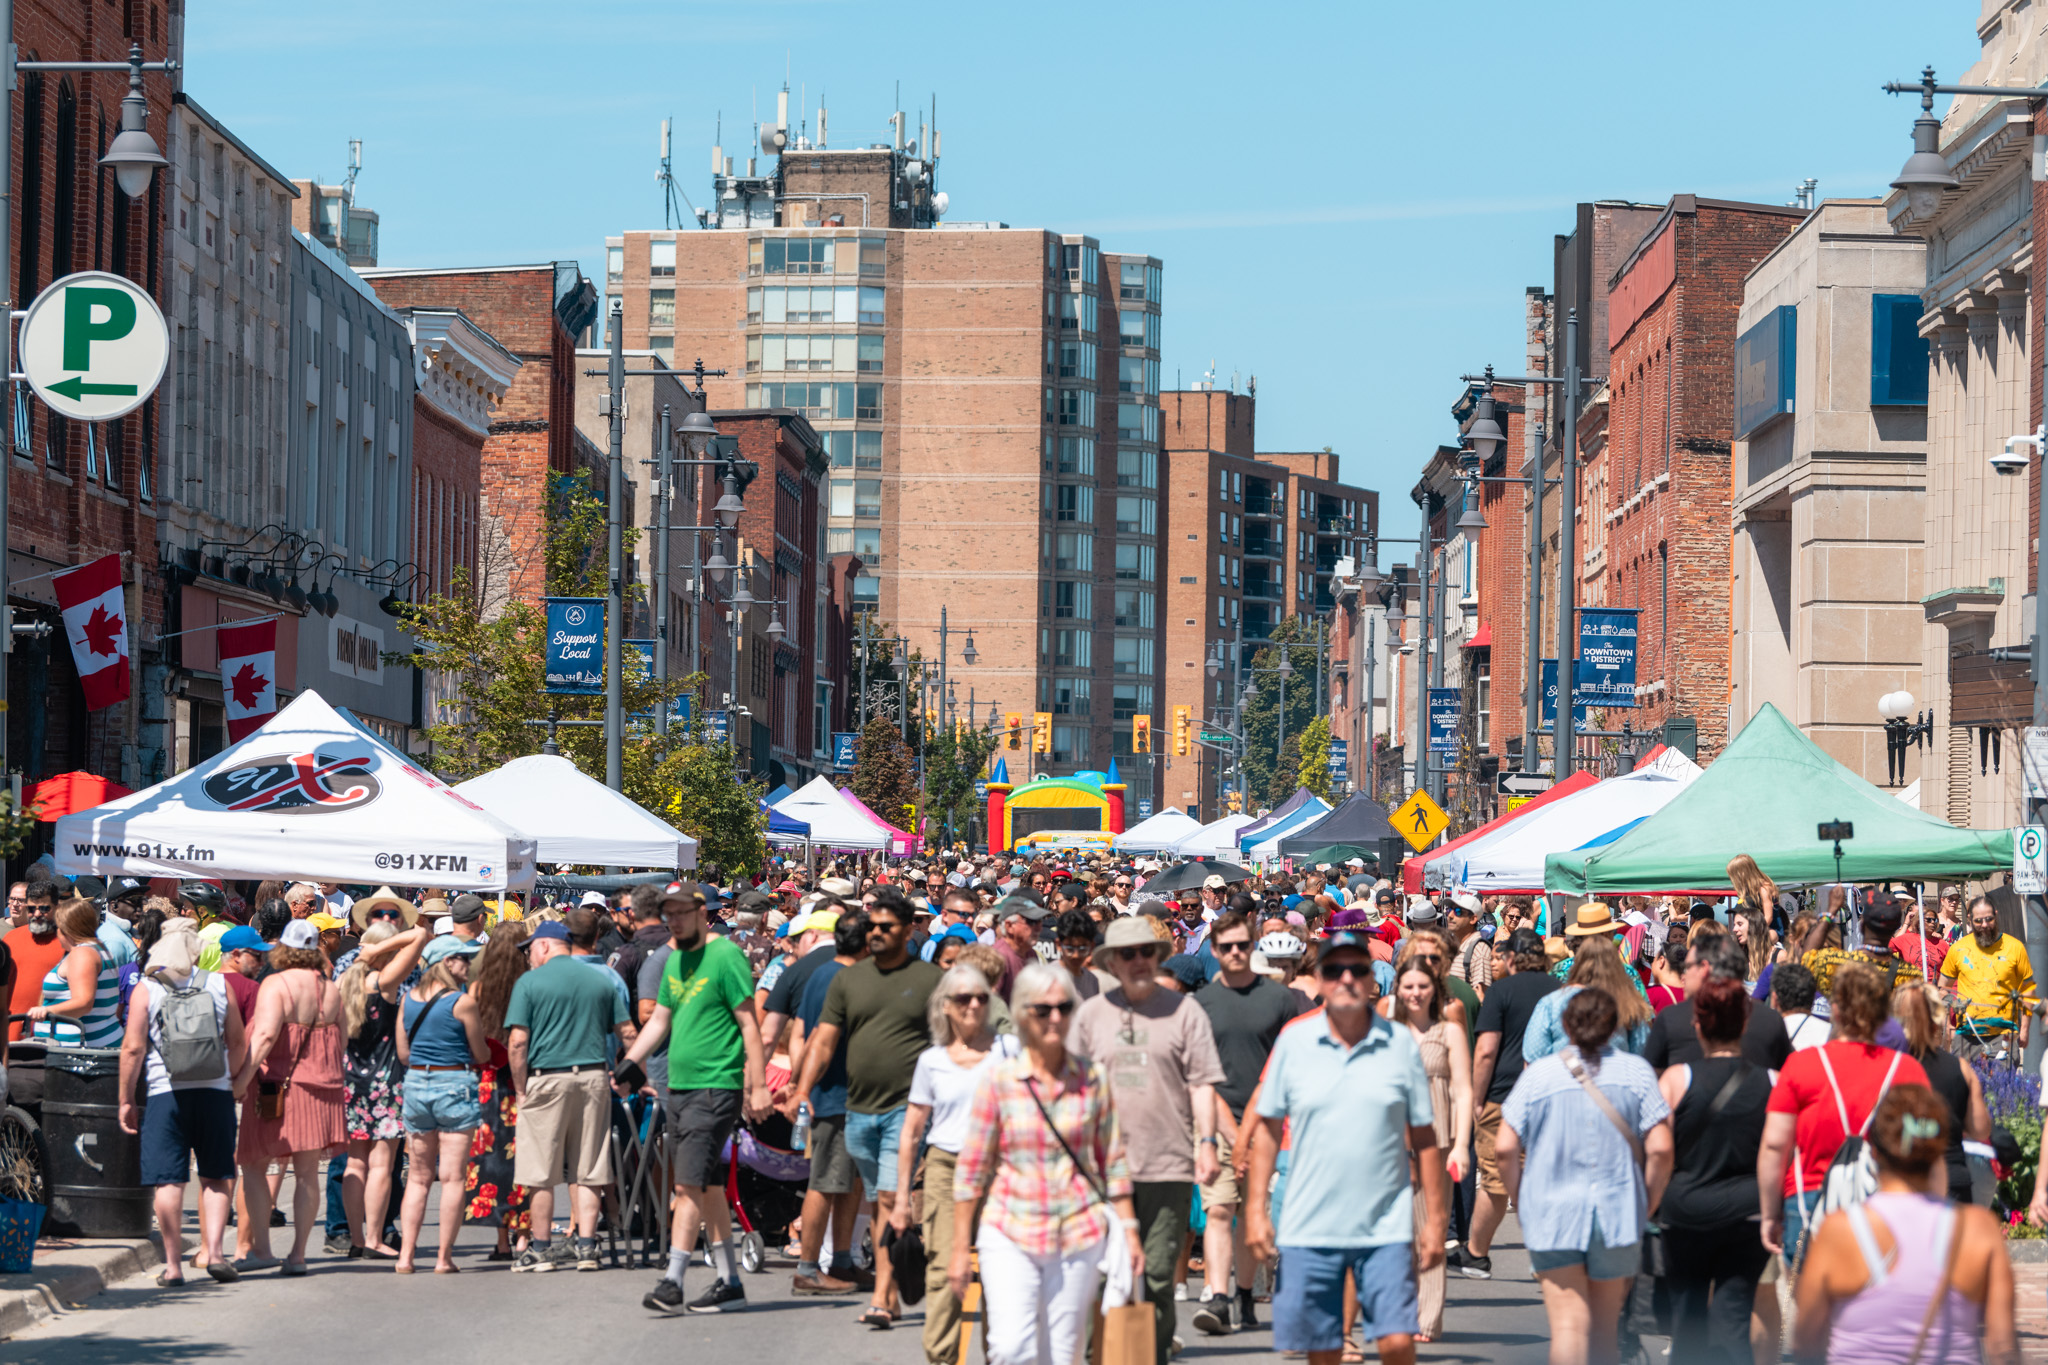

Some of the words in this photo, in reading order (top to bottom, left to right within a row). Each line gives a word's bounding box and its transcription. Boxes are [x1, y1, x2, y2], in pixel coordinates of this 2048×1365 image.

[63, 287, 136, 371] P
[553, 631, 597, 646] Support
[559, 646, 591, 659] Local
[1584, 648, 1633, 656] DOWNTOWN
[73, 842, 215, 861] www.91x.fm
[2027, 837, 2035, 851] P
[375, 852, 467, 872] @91XFM
